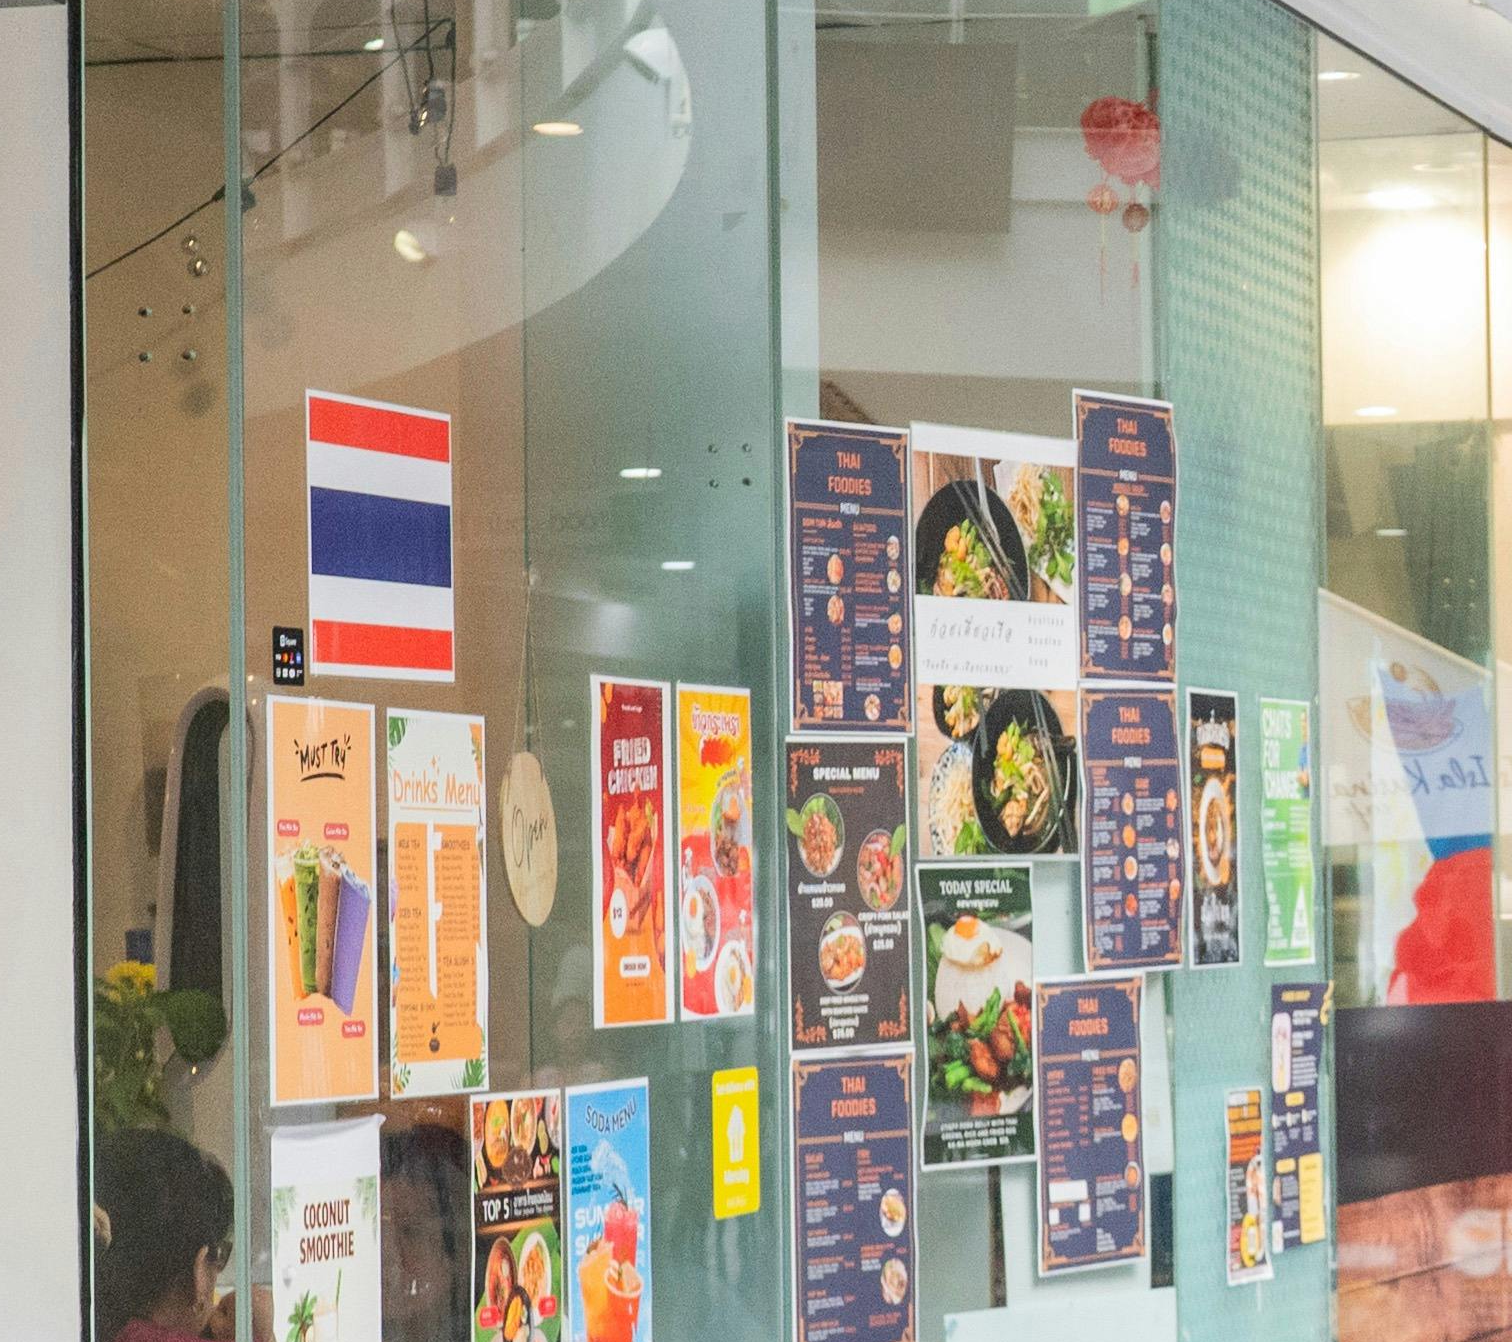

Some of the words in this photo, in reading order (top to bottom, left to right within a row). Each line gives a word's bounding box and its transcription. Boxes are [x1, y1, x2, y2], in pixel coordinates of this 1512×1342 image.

[1117, 418, 1138, 435] THAI
[1109, 438, 1147, 457] FOODIES
[836, 451, 861, 470] THAI
[1119, 469, 1138, 482] MENU
[828, 476, 872, 495] FOODIES
[840, 502, 860, 516] MENU
[1119, 706, 1140, 723] THAI
[1262, 709, 1291, 739] CHATS
[1111, 727, 1151, 745] FOODIES
[300, 744, 327, 773] MUST
[613, 736, 651, 767] FRIED
[1264, 740, 1280, 768] FOR
[607, 764, 658, 795] CHICKEN
[813, 767, 851, 781] SPECIAL
[853, 767, 880, 781] MENU
[393, 769, 438, 803] Drinks
[445, 773, 481, 805] Menu
[939, 880, 972, 898] TODAY
[974, 879, 1013, 894] SPECIAL
[1078, 997, 1099, 1014] THAI
[1069, 1017, 1108, 1036] FOODIES
[841, 1076, 866, 1094] THAI
[586, 1105, 610, 1134] SODA
[612, 1096, 637, 1132] MENU
[831, 1098, 876, 1118] FOODIES
[844, 1130, 864, 1144] MENU
[303, 1199, 350, 1229] COCONUT
[482, 1198, 501, 1222] TOP
[503, 1198, 510, 1219] 5
[300, 1231, 354, 1264] SMOOTHIE
